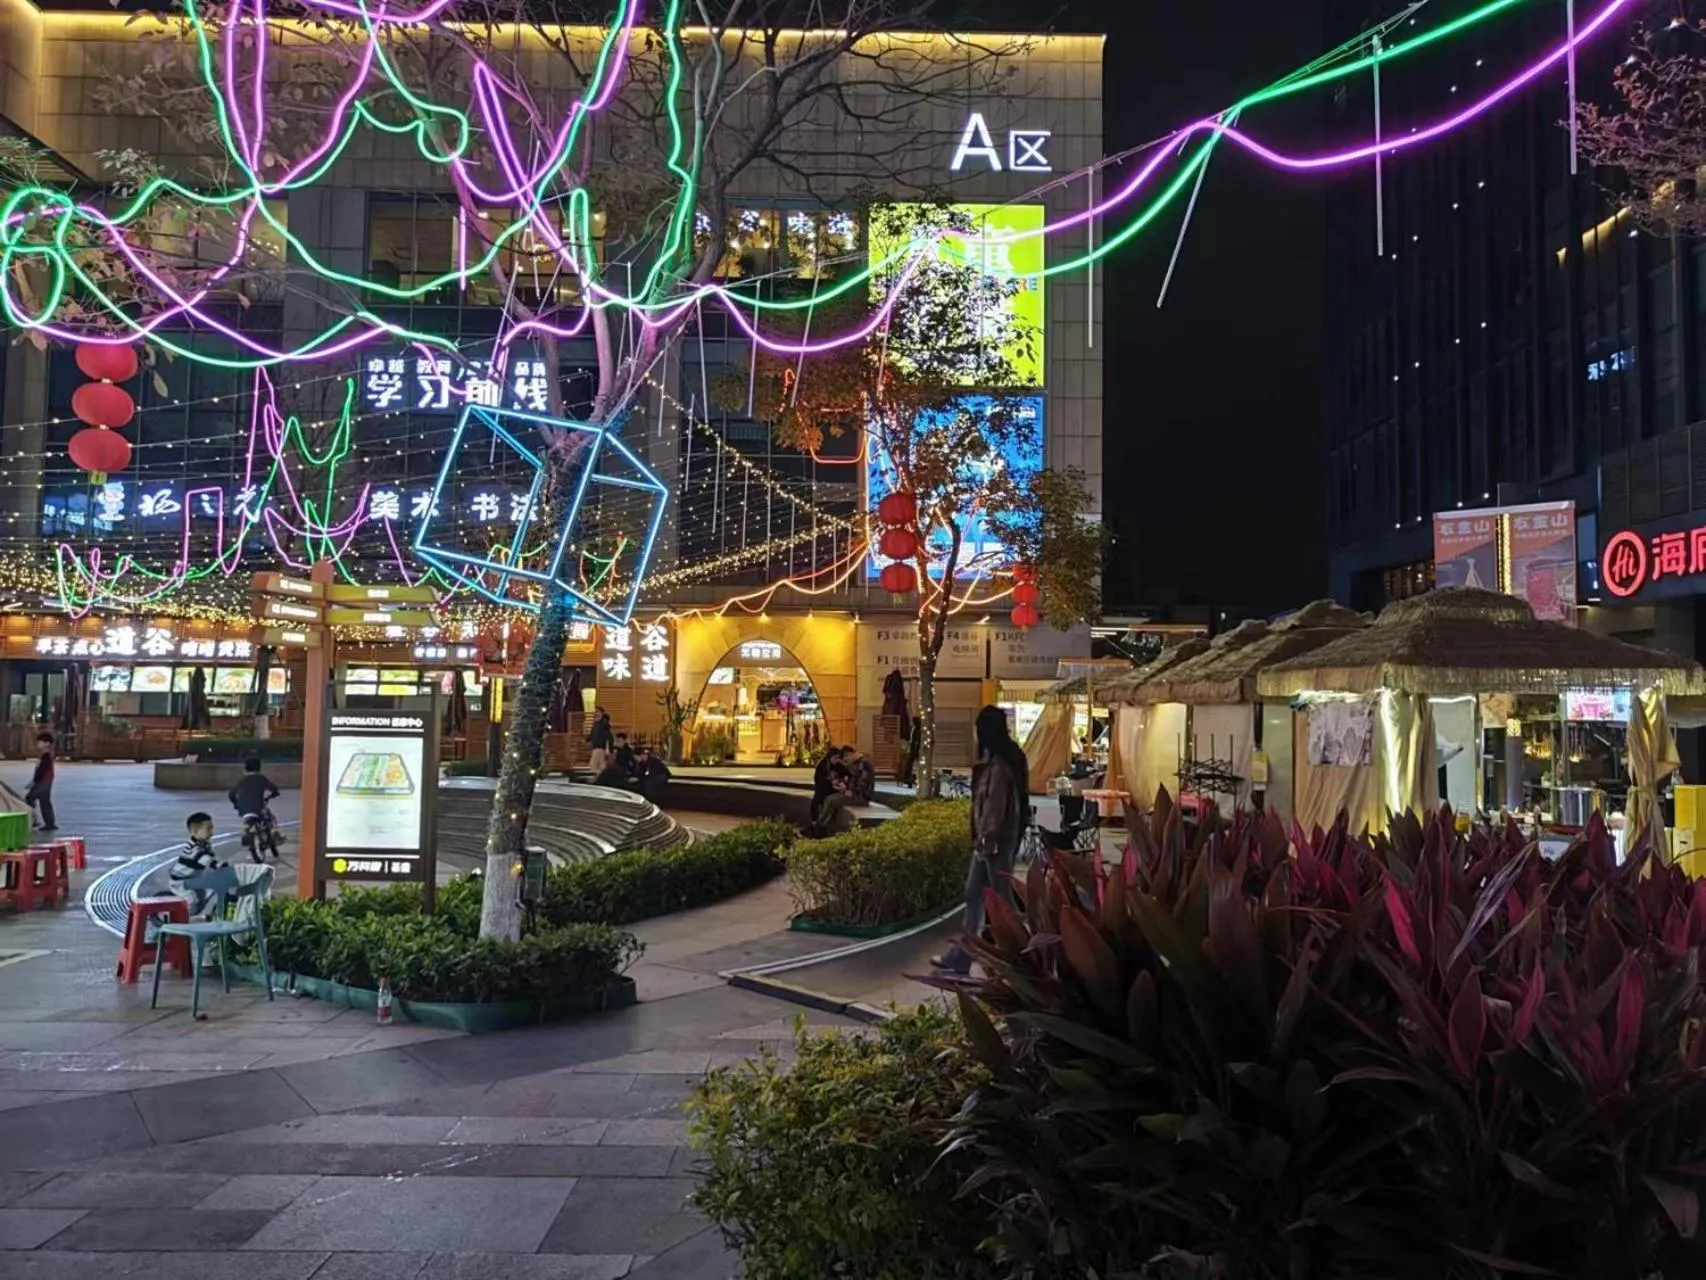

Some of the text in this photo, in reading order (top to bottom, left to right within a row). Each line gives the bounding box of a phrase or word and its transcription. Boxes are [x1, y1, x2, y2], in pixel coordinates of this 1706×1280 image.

[370, 491, 440, 520] 美术
[105, 626, 175, 656] 道谷
[602, 654, 670, 682] 味道
[331, 716, 391, 726] INFORMATION
